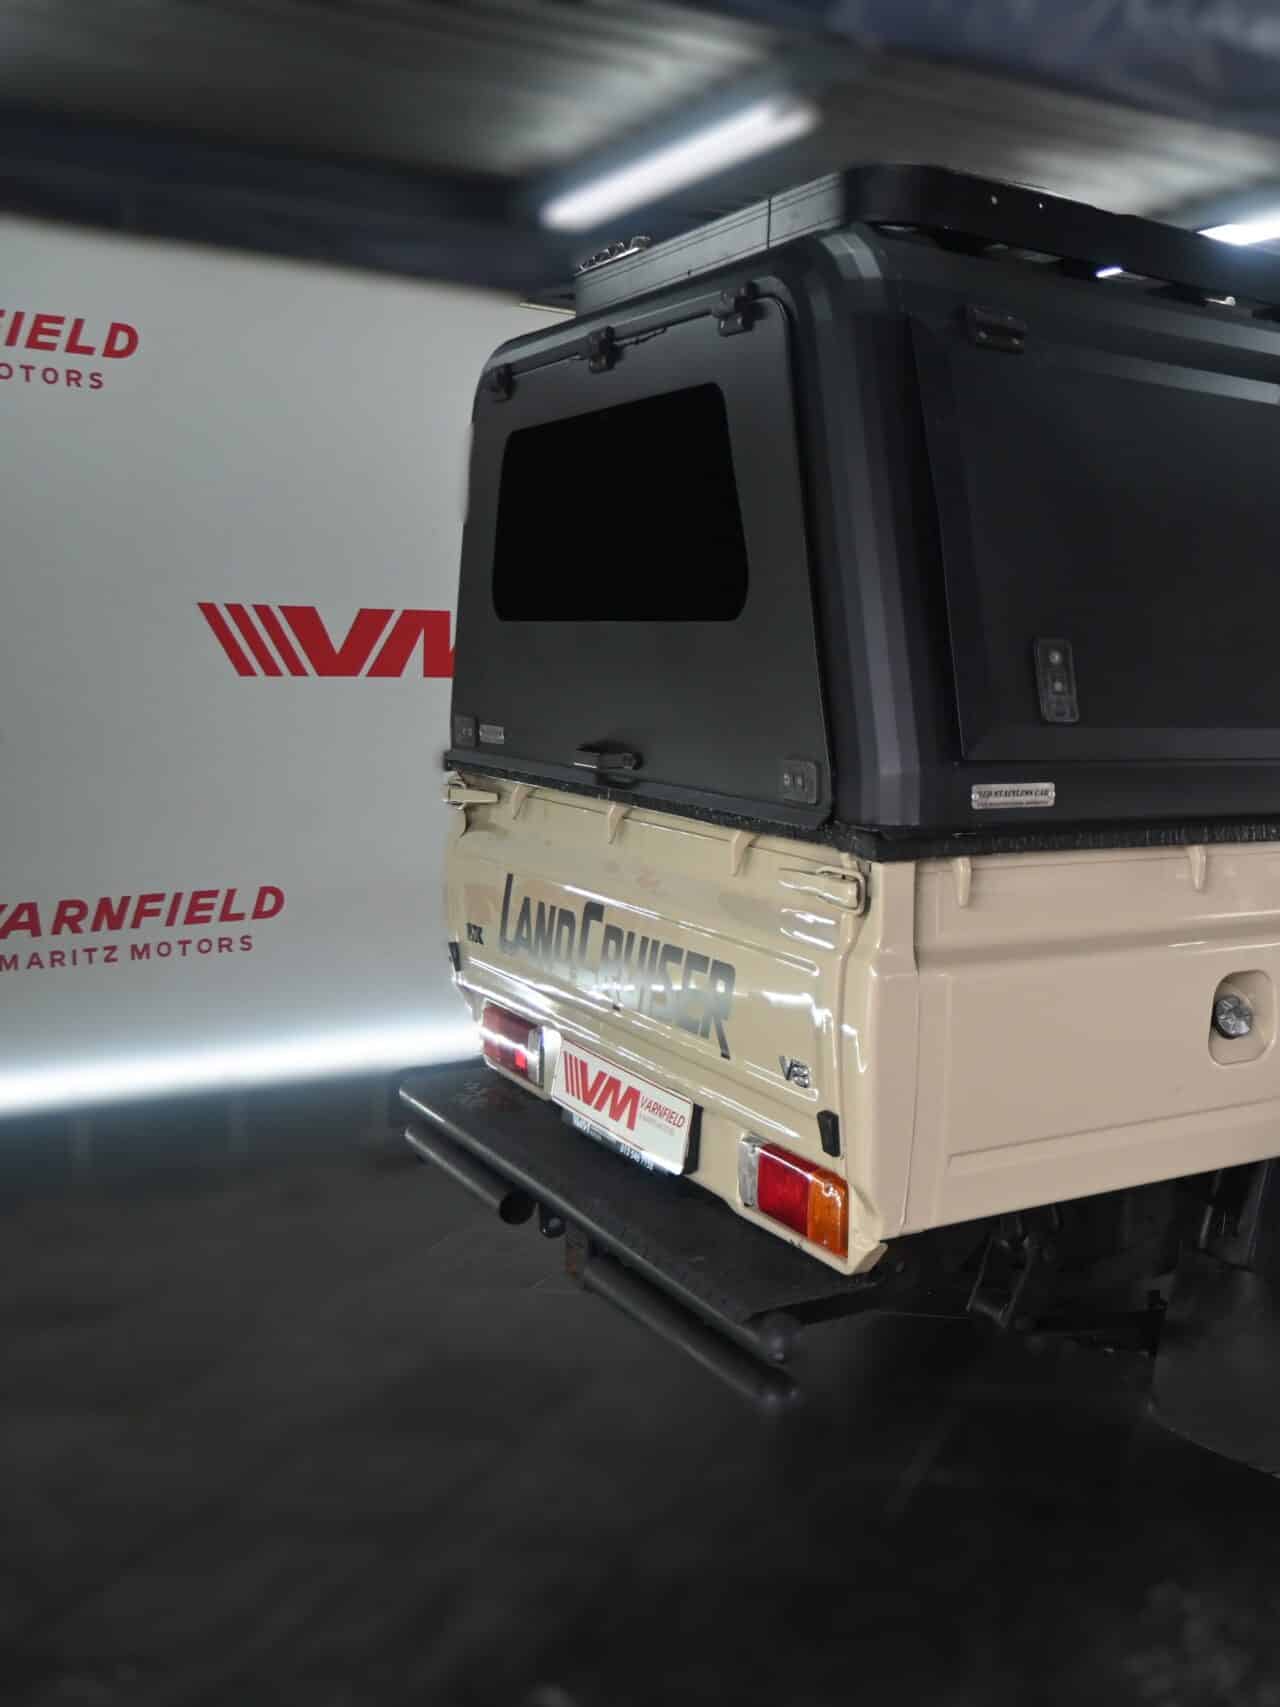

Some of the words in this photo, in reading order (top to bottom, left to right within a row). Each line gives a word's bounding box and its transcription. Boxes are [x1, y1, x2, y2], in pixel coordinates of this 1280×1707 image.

[0, 309, 139, 359] IELD
[0, 885, 286, 939] ARNFIELD
[0, 945, 119, 972] MARITZ
[130, 935, 254, 961] MOTORS
[778, 1055, 810, 1089] V8
[640, 1095, 686, 1129] VARNFIELD
